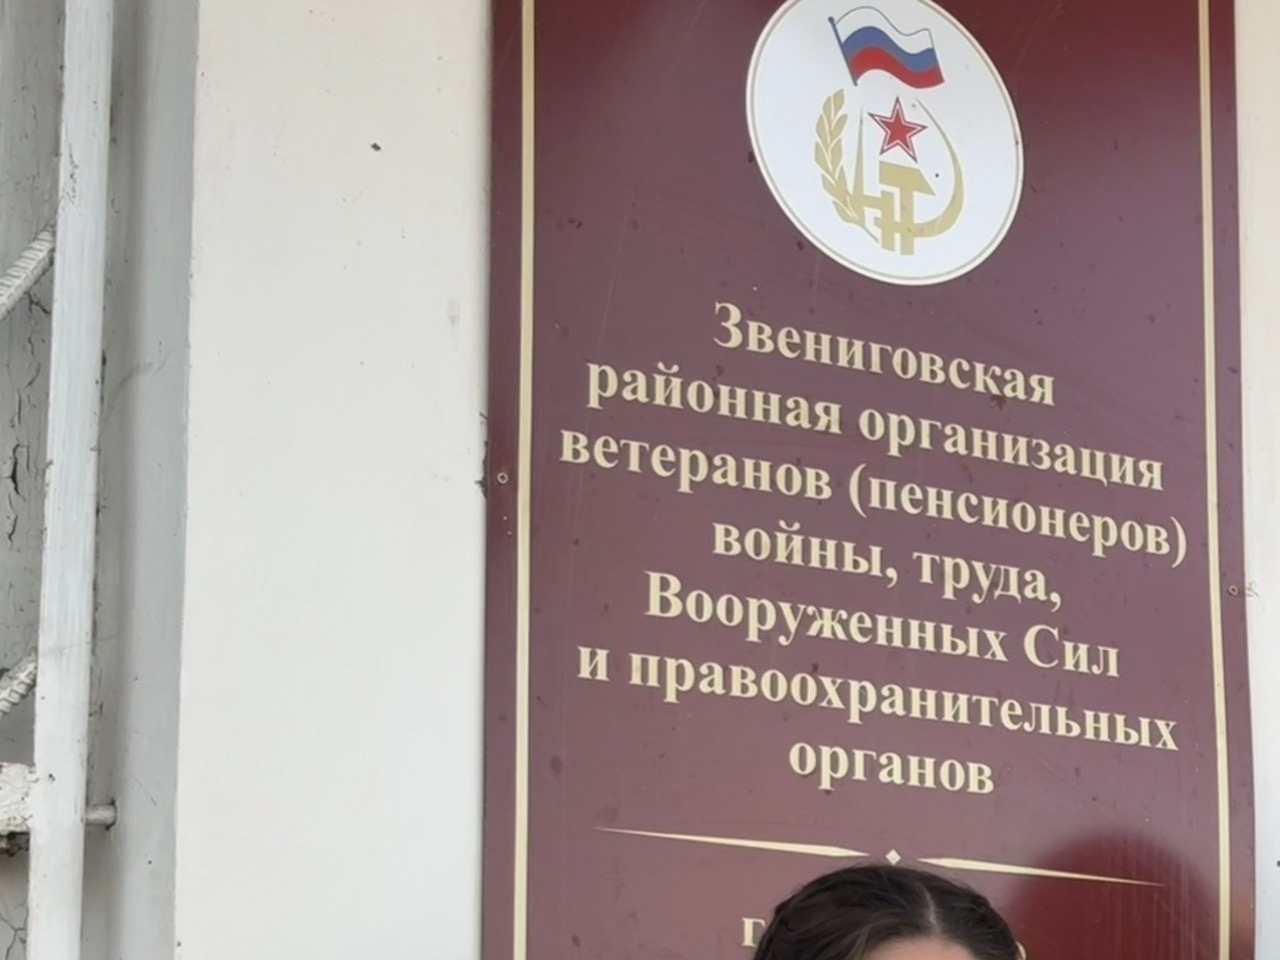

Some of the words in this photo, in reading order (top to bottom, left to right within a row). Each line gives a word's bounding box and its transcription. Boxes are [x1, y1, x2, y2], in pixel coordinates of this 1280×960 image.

[714, 302, 1056, 406] Звениговская
[587, 361, 843, 434] районная
[858, 409, 1164, 491] организация
[560, 430, 833, 500] ветеранов
[849, 464, 1188, 568] (пенсионеров)
[713, 522, 899, 588] войны,
[912, 551, 1062, 612] труда,
[645, 570, 1010, 662] Вооруженных
[1023, 624, 1120, 678] Сил
[578, 646, 610, 682] и
[628, 653, 1180, 752] правоохранительных
[788, 741, 994, 794] органов
